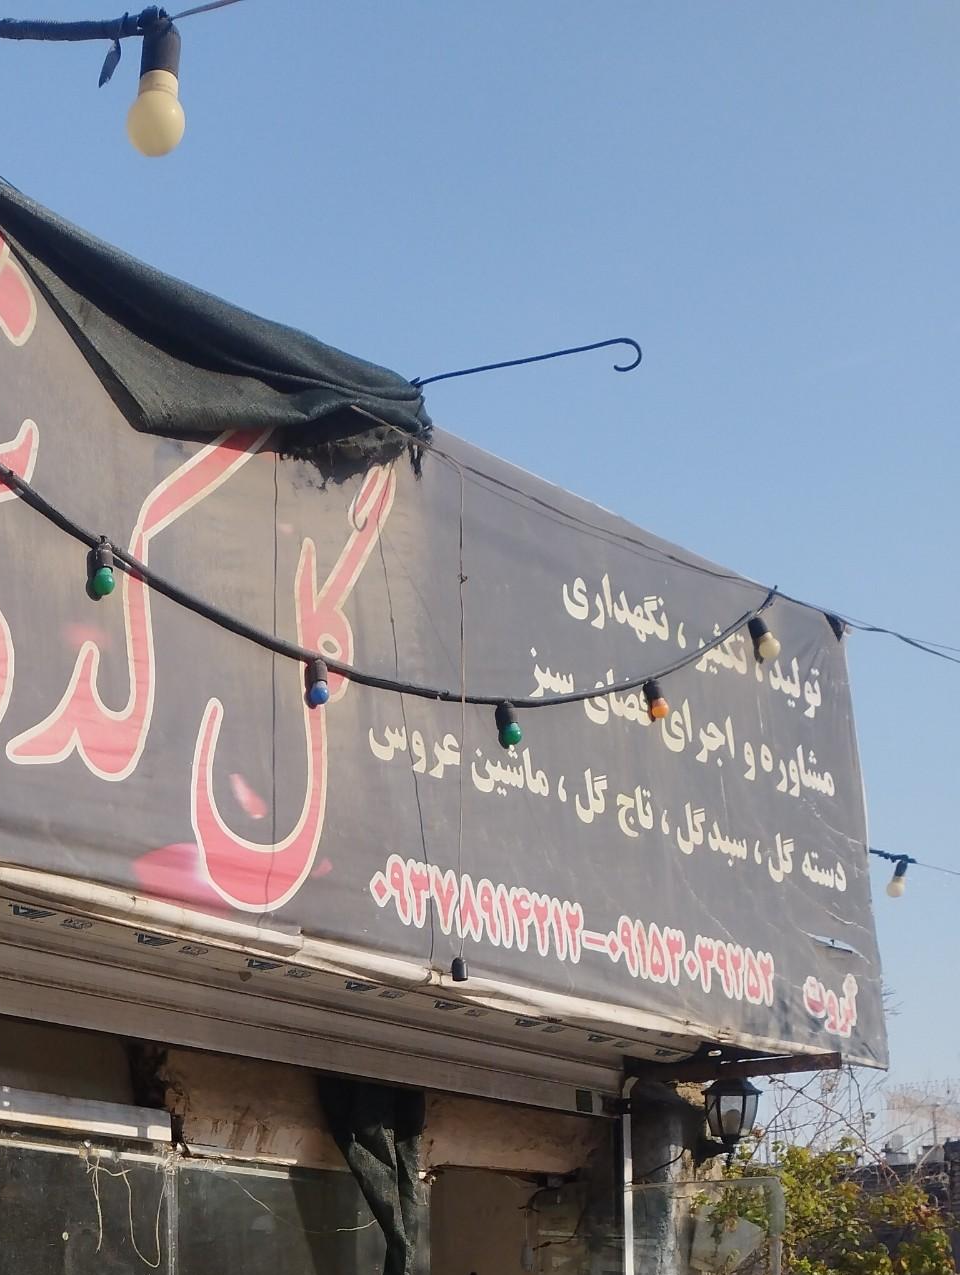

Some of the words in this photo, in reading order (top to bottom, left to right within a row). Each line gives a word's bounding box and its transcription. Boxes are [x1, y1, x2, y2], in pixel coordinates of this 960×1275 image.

[562, 572, 669, 643] نگهداری
[528, 646, 574, 698] سبز
[695, 622, 748, 675] تکثیر
[768, 656, 822, 719] تولید
[368, 724, 462, 779] عروس
[661, 697, 735, 768] اجرای
[471, 744, 550, 797] ماشین
[743, 741, 756, 781] و
[759, 743, 836, 798] مشاوره
[575, 767, 608, 824] گل
[615, 784, 654, 838] تاج
[767, 832, 795, 883] گل
[801, 850, 848, 892] دسته
